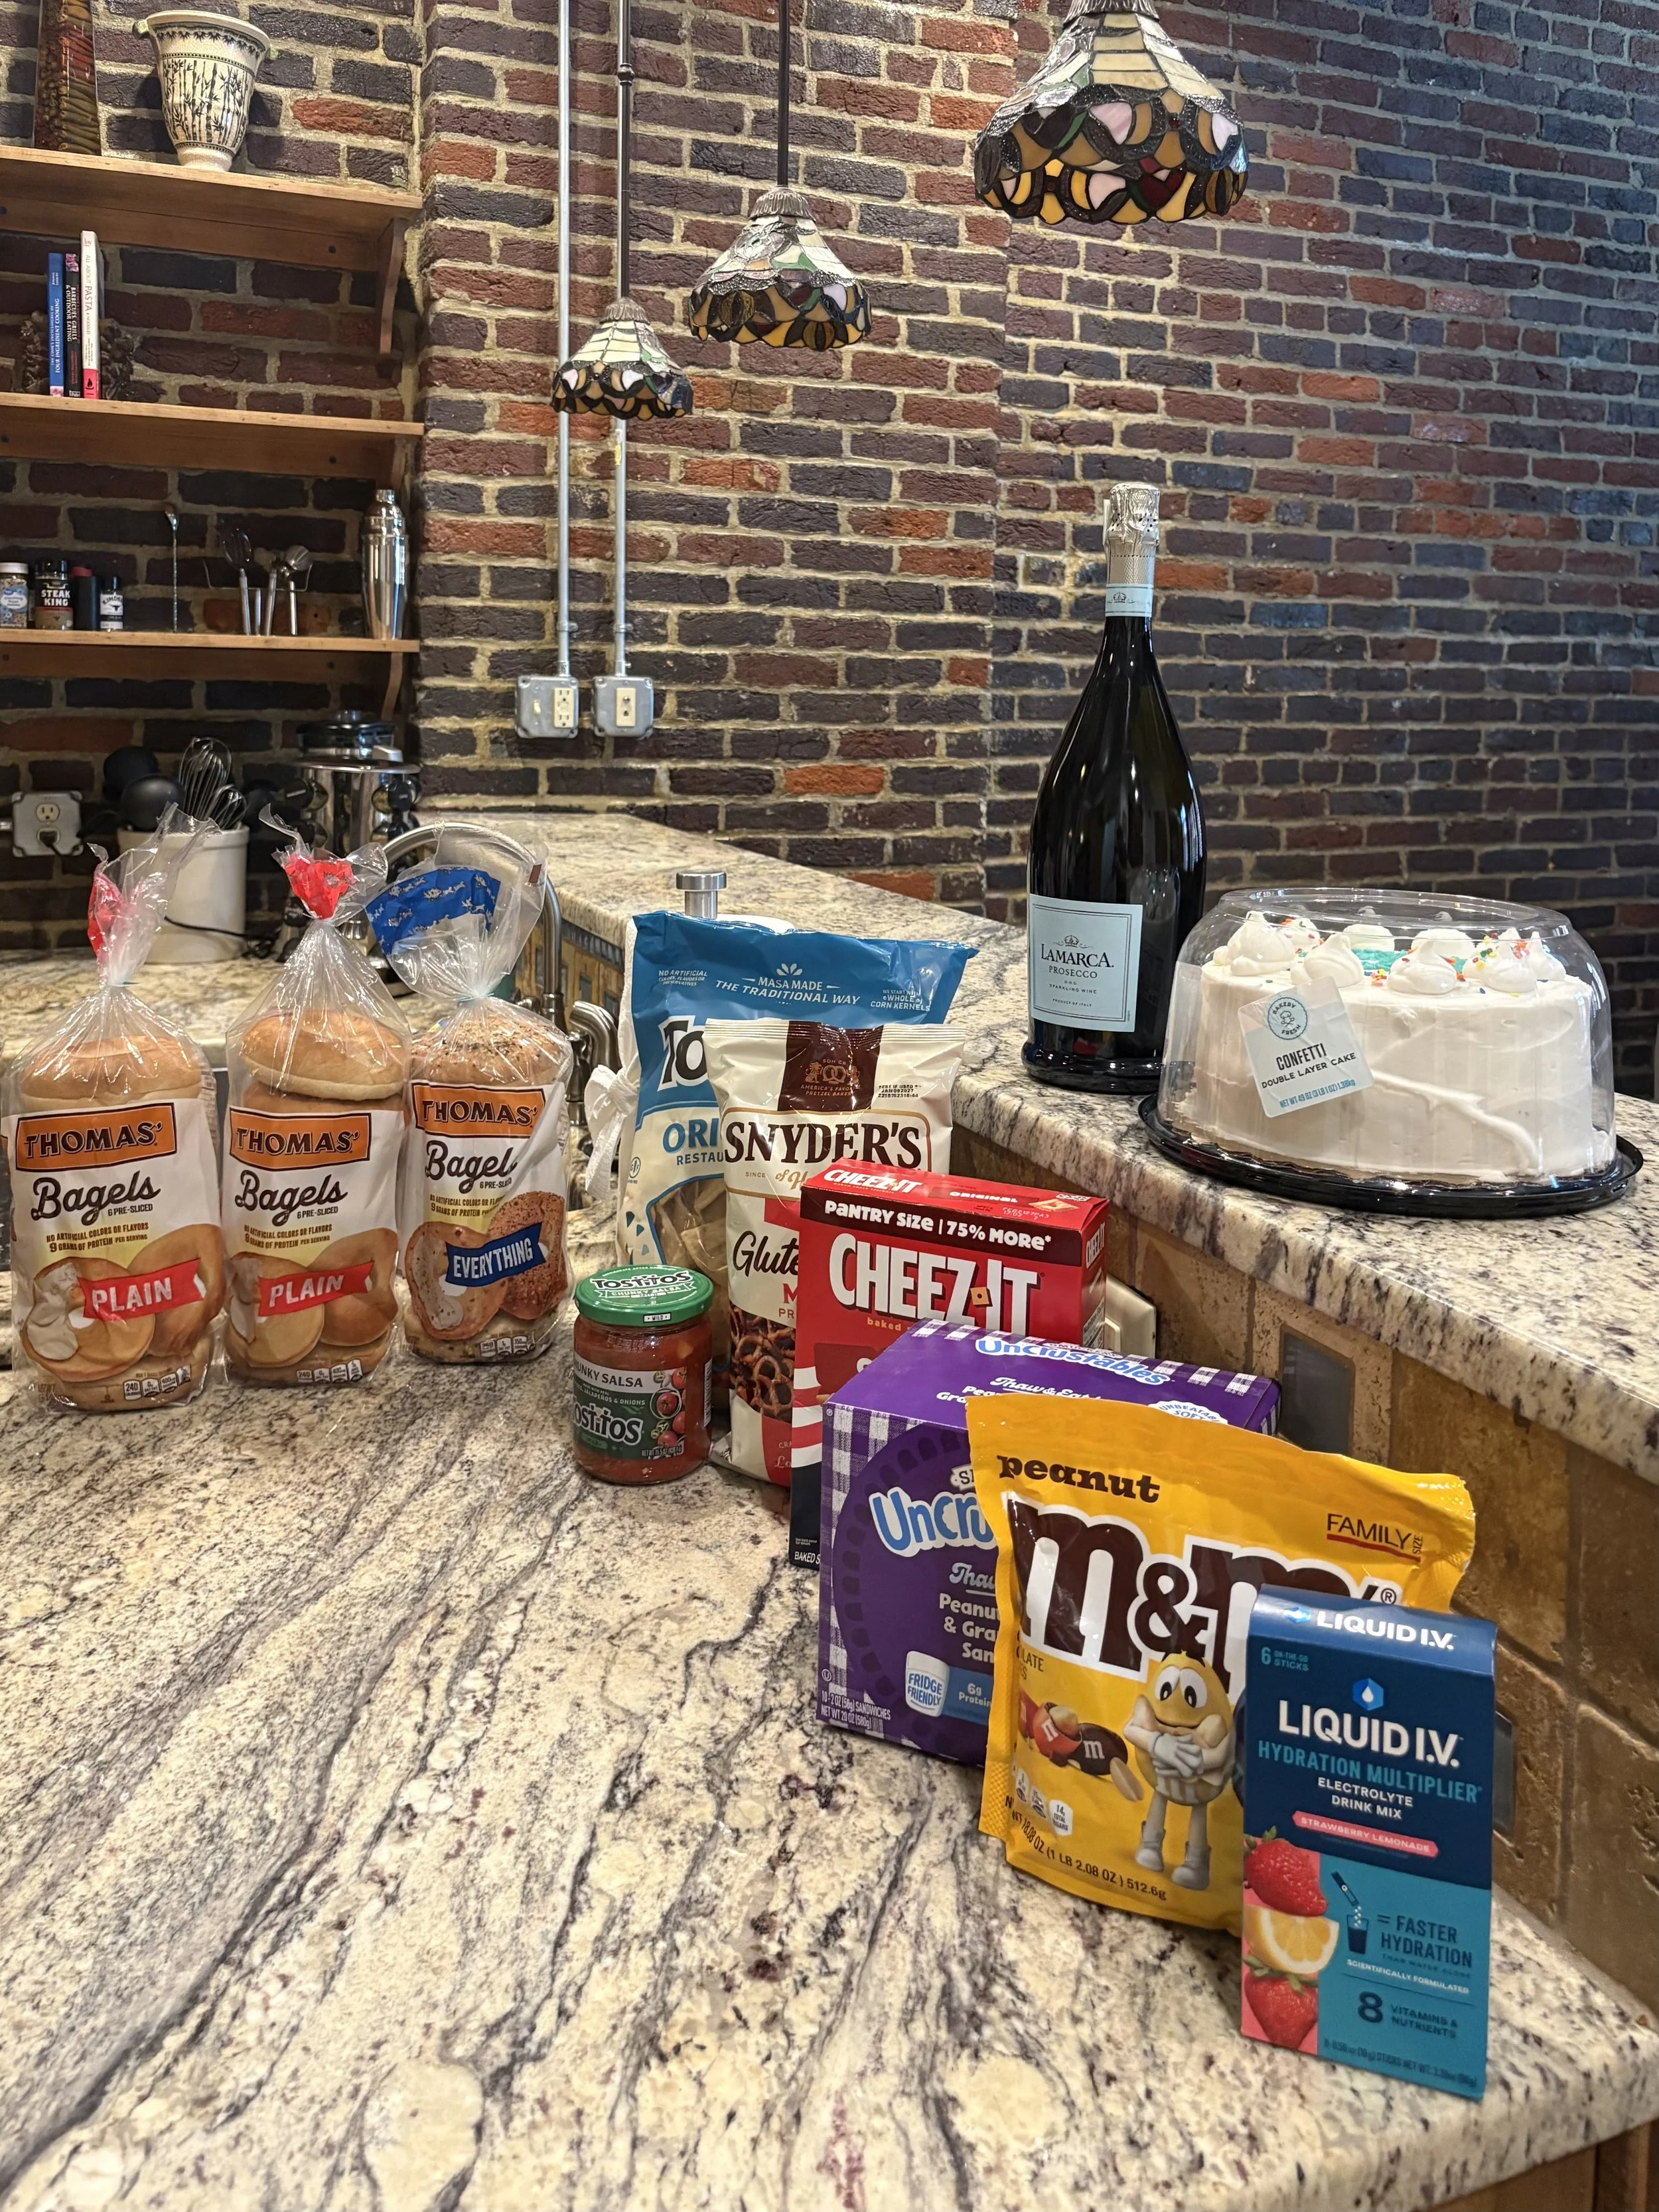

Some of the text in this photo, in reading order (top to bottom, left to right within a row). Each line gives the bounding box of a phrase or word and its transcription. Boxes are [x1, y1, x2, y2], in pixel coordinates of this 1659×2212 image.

[41, 589, 71, 599] STEAK
[44, 598, 68, 607] KING
[758, 976, 823, 992] MASA MADE
[1048, 965, 1098, 979] PROSECCO
[715, 980, 861, 1005] THE TRADITIONAL WAY
[1049, 984, 1080, 992] SPARKLING
[893, 1002, 931, 1012] KERNELS
[1272, 1001, 1296, 1015] BAKERY
[1281, 1024, 1301, 1035] FRESH
[1275, 1043, 1328, 1071] CONFETTI
[1261, 1052, 1357, 1089] DOUBLE LAYER CAKE
[1279, 1098, 1290, 1108] NET
[1289, 1096, 1299, 1105] WT
[1305, 1091, 1313, 1100] OZ
[421, 1100, 538, 1127] THOMAS'
[24, 1120, 163, 1159] THOMAS'
[236, 1128, 360, 1155] THOMAS'
[724, 1121, 922, 1169] SNYDER'S
[425, 1140, 518, 1194] Bagel
[676, 1149, 724, 1166] RESTAU
[31, 1170, 161, 1226] Bagels
[108, 1203, 153, 1217] 6 PRE-SLICED
[234, 1169, 348, 1227] Bagels
[49, 1241, 58, 1253] 9
[58, 1242, 78, 1252] GRAMS
[78, 1241, 86, 1250] OF
[88, 1238, 113, 1249] PROTEIN
[126, 1234, 148, 1242] SERVING
[56, 1230, 88, 1241] ARTIFICIAL
[89, 1227, 112, 1238] COLORS
[113, 1225, 121, 1234] OR
[122, 1222, 149, 1232] FLAVORS
[946, 1223, 987, 1242] 75%
[453, 1237, 534, 1279] EVERYTHING
[733, 1230, 799, 1278] Glute
[92, 1276, 174, 1313] PLAIN
[269, 1274, 344, 1308] PLAIN
[867, 1317, 901, 1332] baked
[575, 1361, 644, 1388] UNKY SALSA
[975, 1338, 1171, 1386] Uncrustables
[125, 1382, 139, 1392] 240
[989, 1376, 1045, 1393] Thaw
[997, 1453, 1161, 1504] peanut
[1327, 1512, 1425, 1556] FAMILY SIZE
[794, 1551, 816, 1564] BAKED
[943, 1615, 956, 1635] &
[1316, 1609, 1455, 1652] LIQUID I.V.
[1260, 1646, 1271, 1666] 6
[1273, 1659, 1311, 1672] STICKS
[907, 1686, 942, 1706] FRIENDLY
[908, 1672, 942, 1696] FRIDGE
[967, 1682, 982, 1696] 6g
[822, 1690, 828, 1702] 10
[830, 1694, 834, 1705] 2
[834, 1694, 841, 1707] OZ
[855, 1701, 891, 1721] SANDWICHES
[958, 1691, 991, 1708] Protein
[821, 1704, 831, 1718] NET
[831, 1707, 840, 1720] WT
[841, 1710, 847, 1722] 20
[848, 1712, 855, 1724] OZ
[1278, 1699, 1460, 1769] LIQUID I.V.
[1258, 1739, 1479, 1805] HYDRATION MULTIPLIER
[1317, 1776, 1414, 1808] ELECTROLYTE
[1053, 1812, 1066, 1824] TOTAL
[1331, 1794, 1403, 1820] DRINK MIX
[1299, 1815, 1370, 1841] STRAWBERRY
[1372, 1832, 1431, 1854] LEMONADE
[1021, 1817, 1168, 1901] 18.08 OZ (1 LB 2.08 OZ 512.6g
[1396, 1914, 1459, 1945] FASTER
[1380, 1931, 1473, 1969] HYDRATION
[1346, 1958, 1470, 1994] SCIENTIFICALLY FORMULATED
[1356, 1990, 1384, 2024] 8
[1390, 2003, 1449, 2026] VITAMINS
[1390, 2016, 1457, 2039] NUTRIENTS
